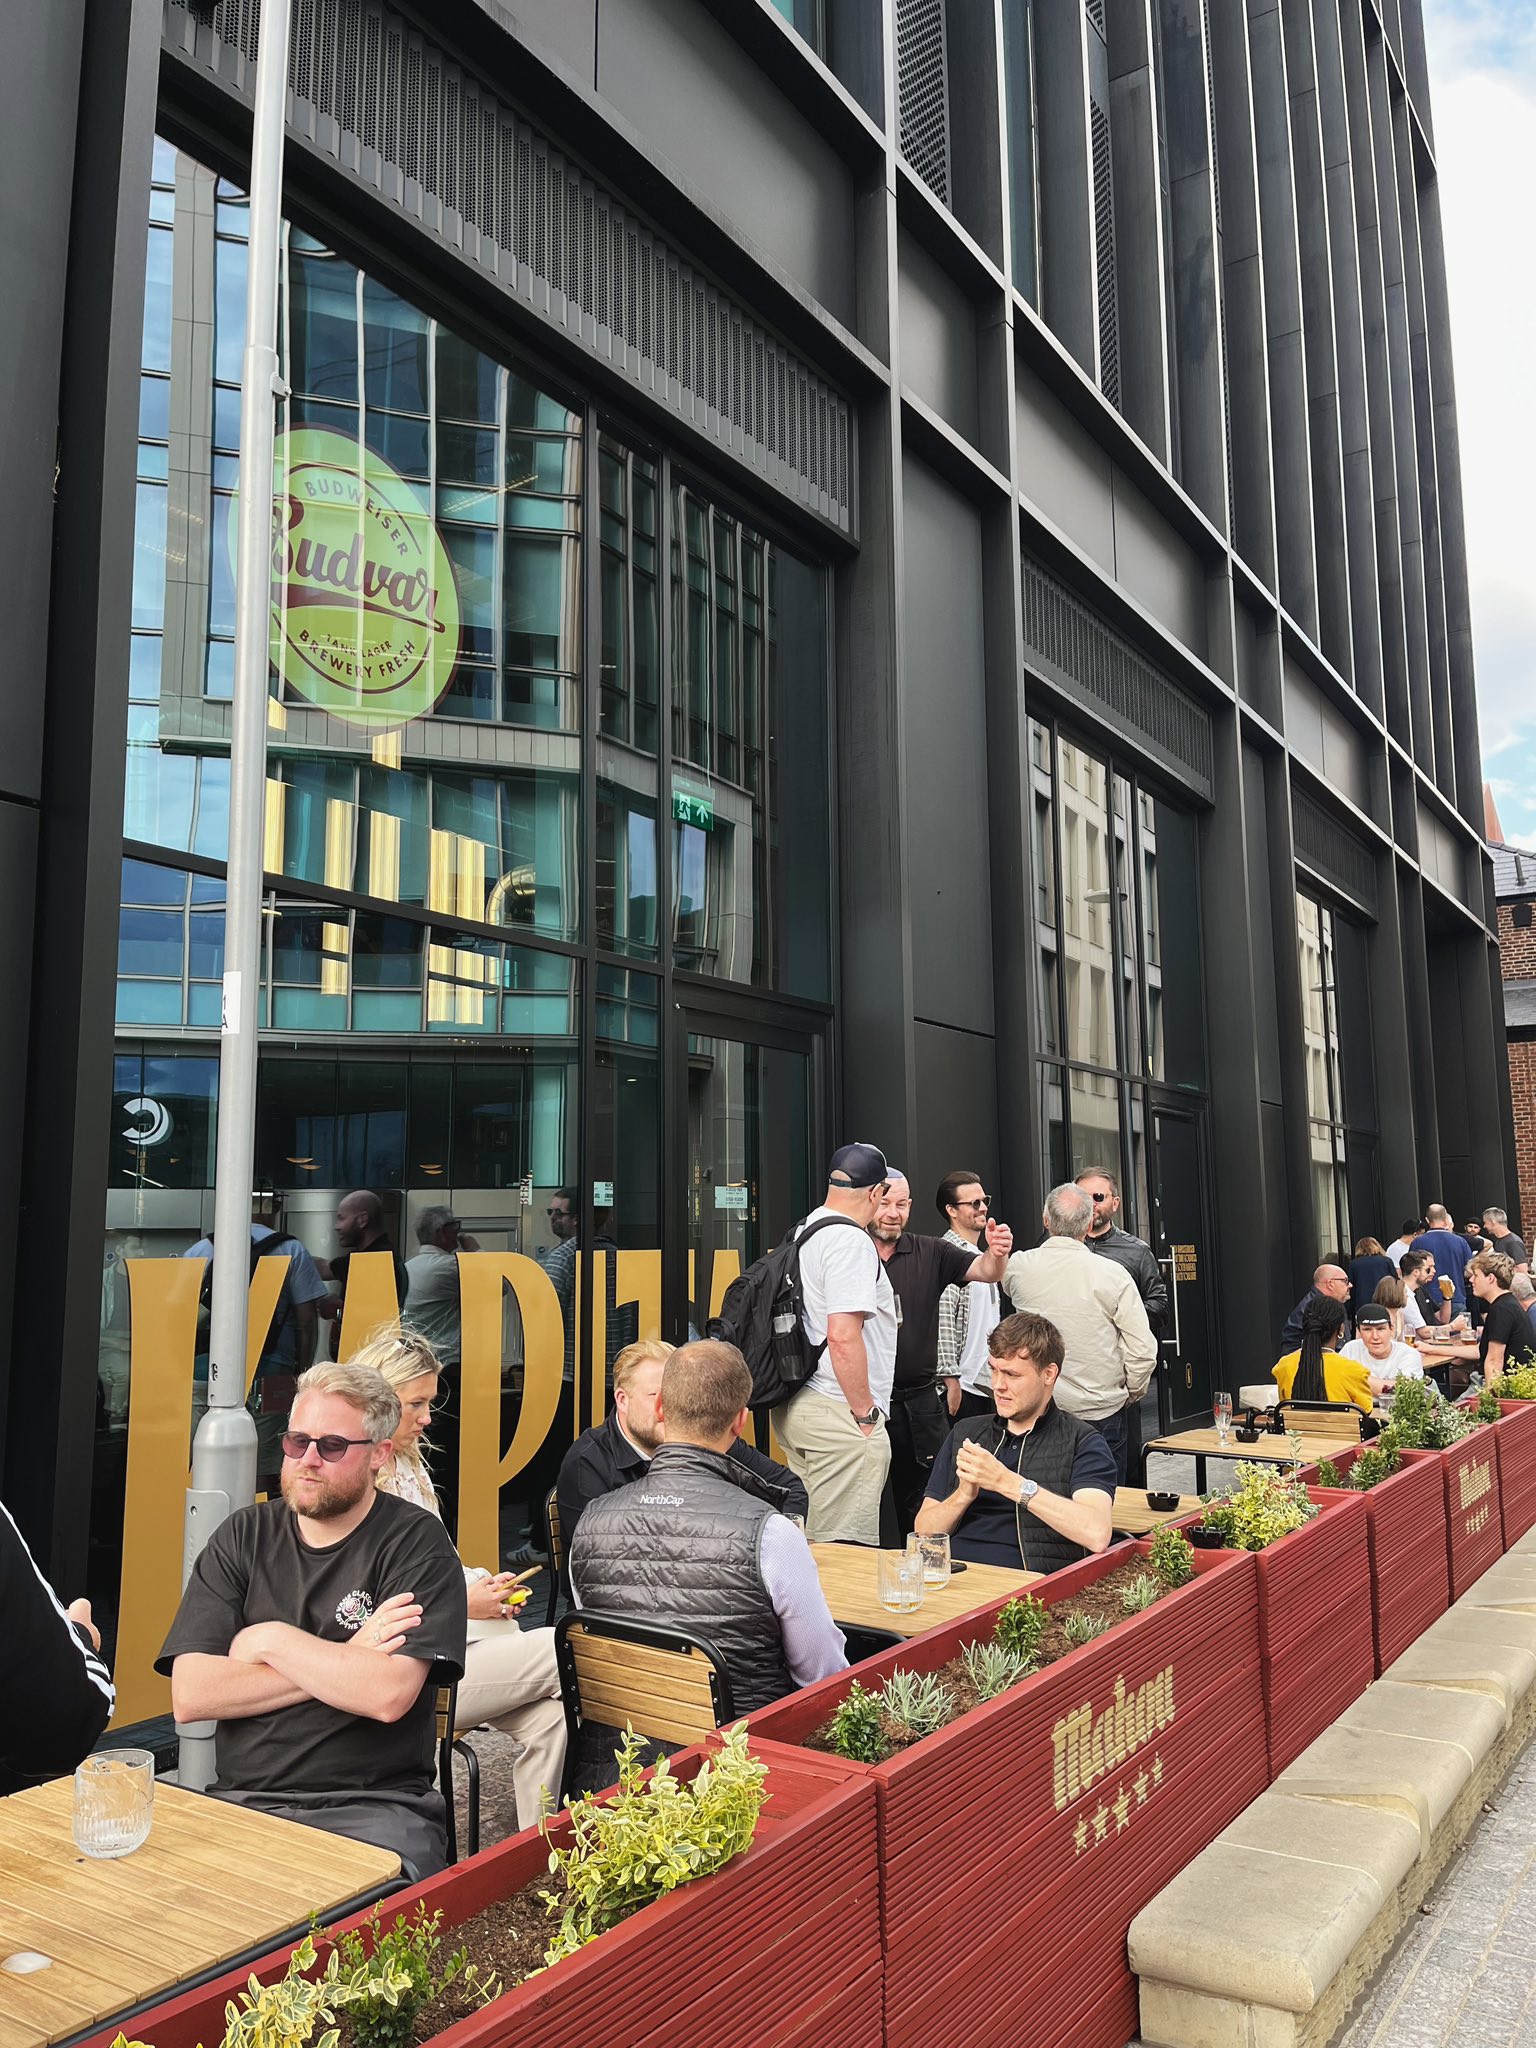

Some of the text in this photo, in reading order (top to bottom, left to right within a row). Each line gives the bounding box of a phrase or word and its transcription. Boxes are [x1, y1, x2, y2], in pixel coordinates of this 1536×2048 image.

[304, 478, 409, 556] BUDWEISER
[299, 629, 416, 679] BREWERY FRESH
[325, 633, 393, 659] TANK LAGER
[520, 1178, 529, 1205] BEER
[639, 1494, 685, 1507] NorthCap
[344, 1622, 359, 1630] THE
